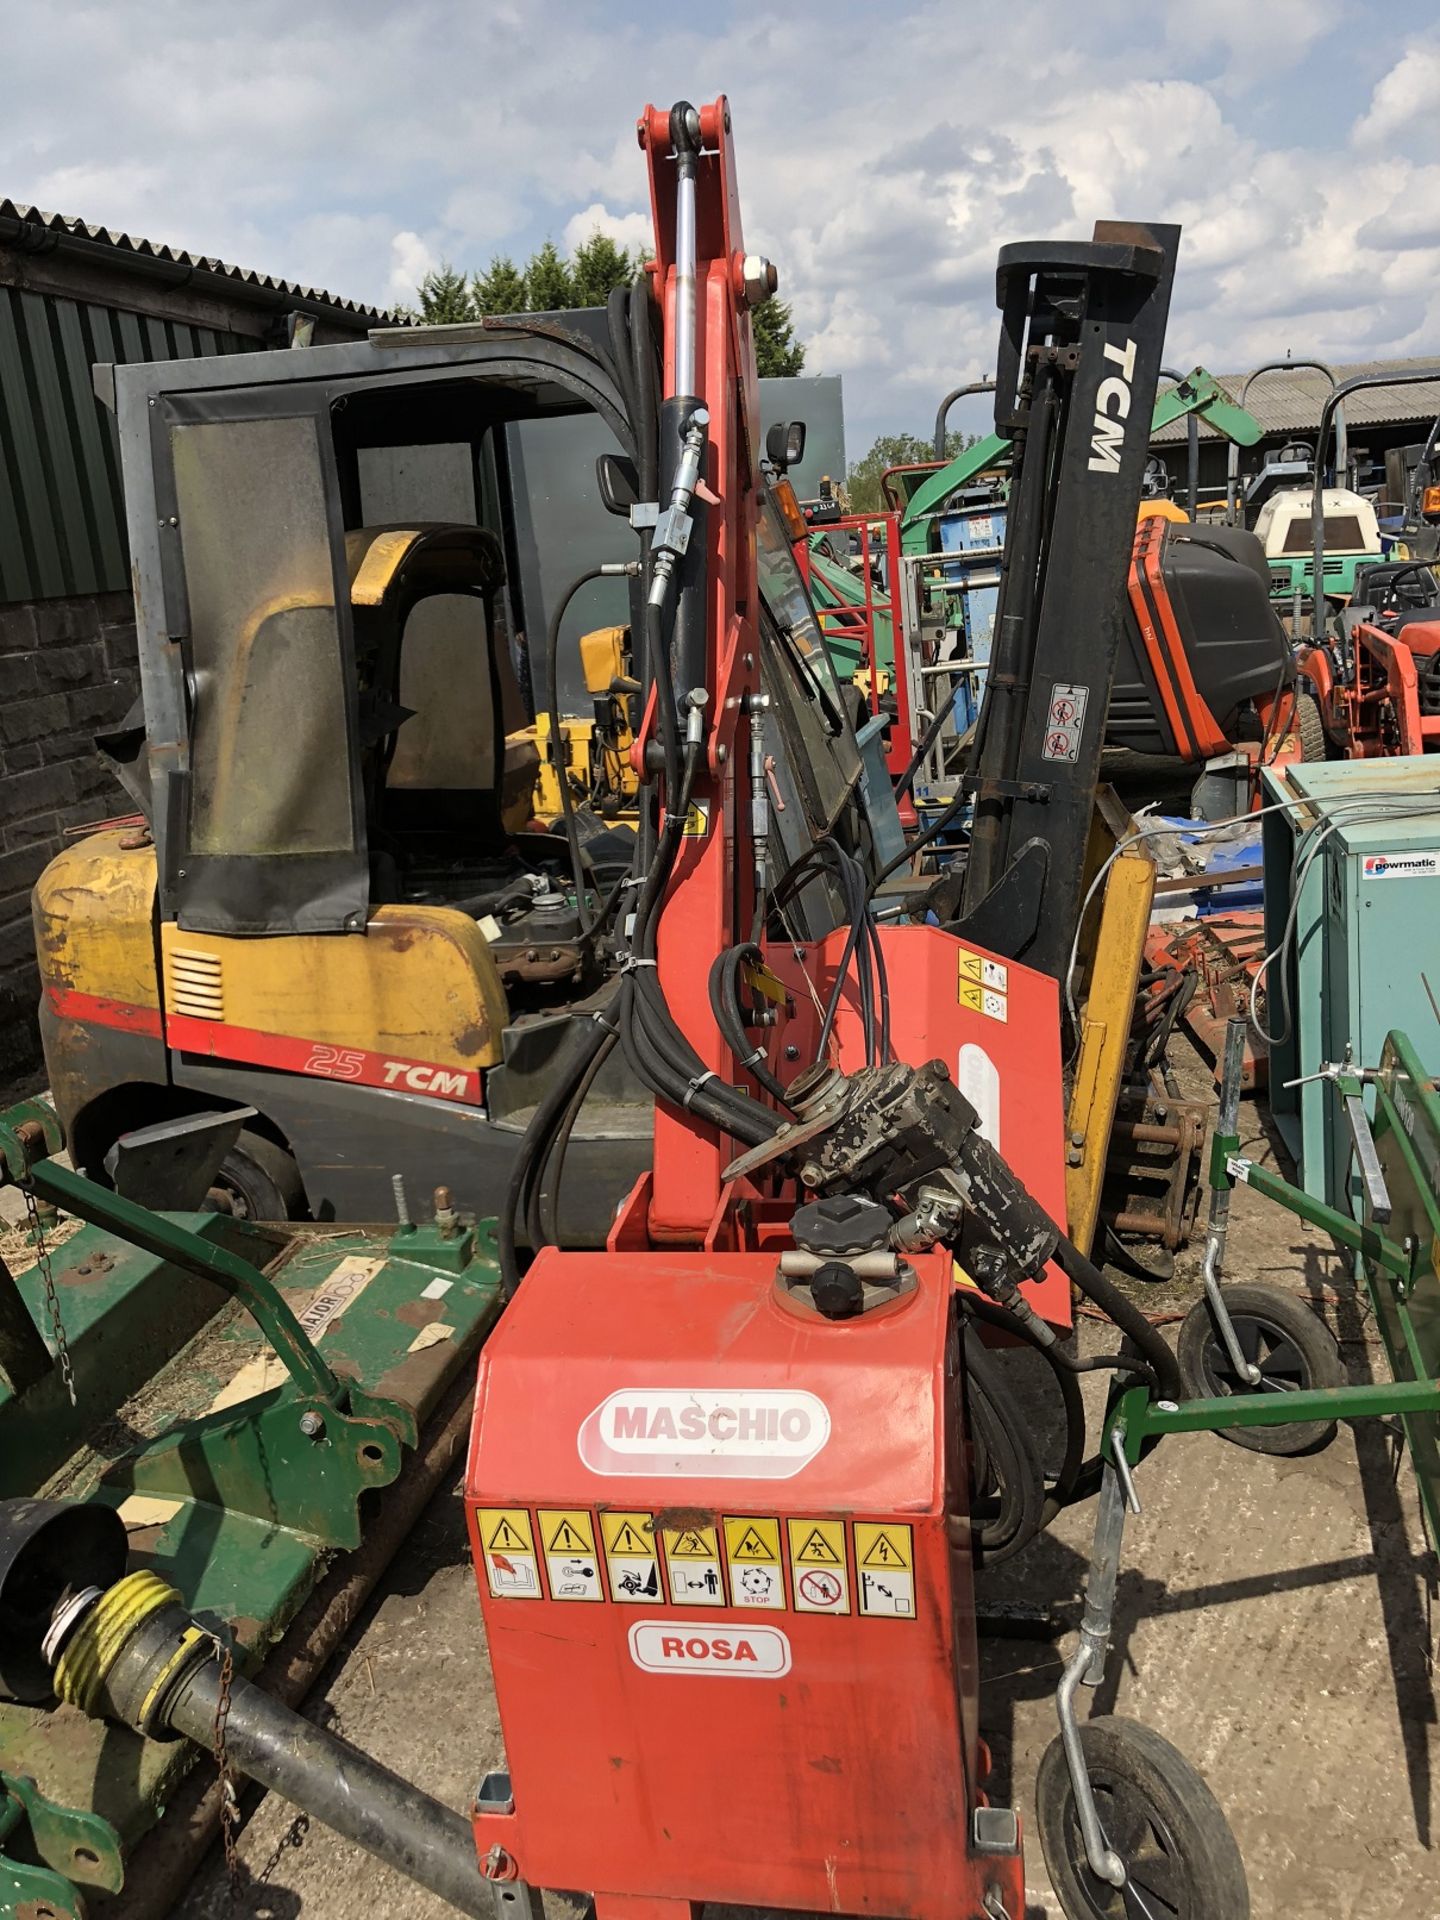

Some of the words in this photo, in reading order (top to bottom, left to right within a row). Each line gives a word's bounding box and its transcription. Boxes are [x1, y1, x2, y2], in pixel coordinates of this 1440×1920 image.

[1088, 338, 1138, 473] TCM
[1375, 859, 1436, 871] powrmatic
[304, 1045, 366, 1080] 25
[383, 1061, 469, 1097] TCM
[613, 1406, 812, 1442] MASCHIO
[743, 1596, 770, 1604] STOP
[661, 1636, 758, 1662] ROSA
